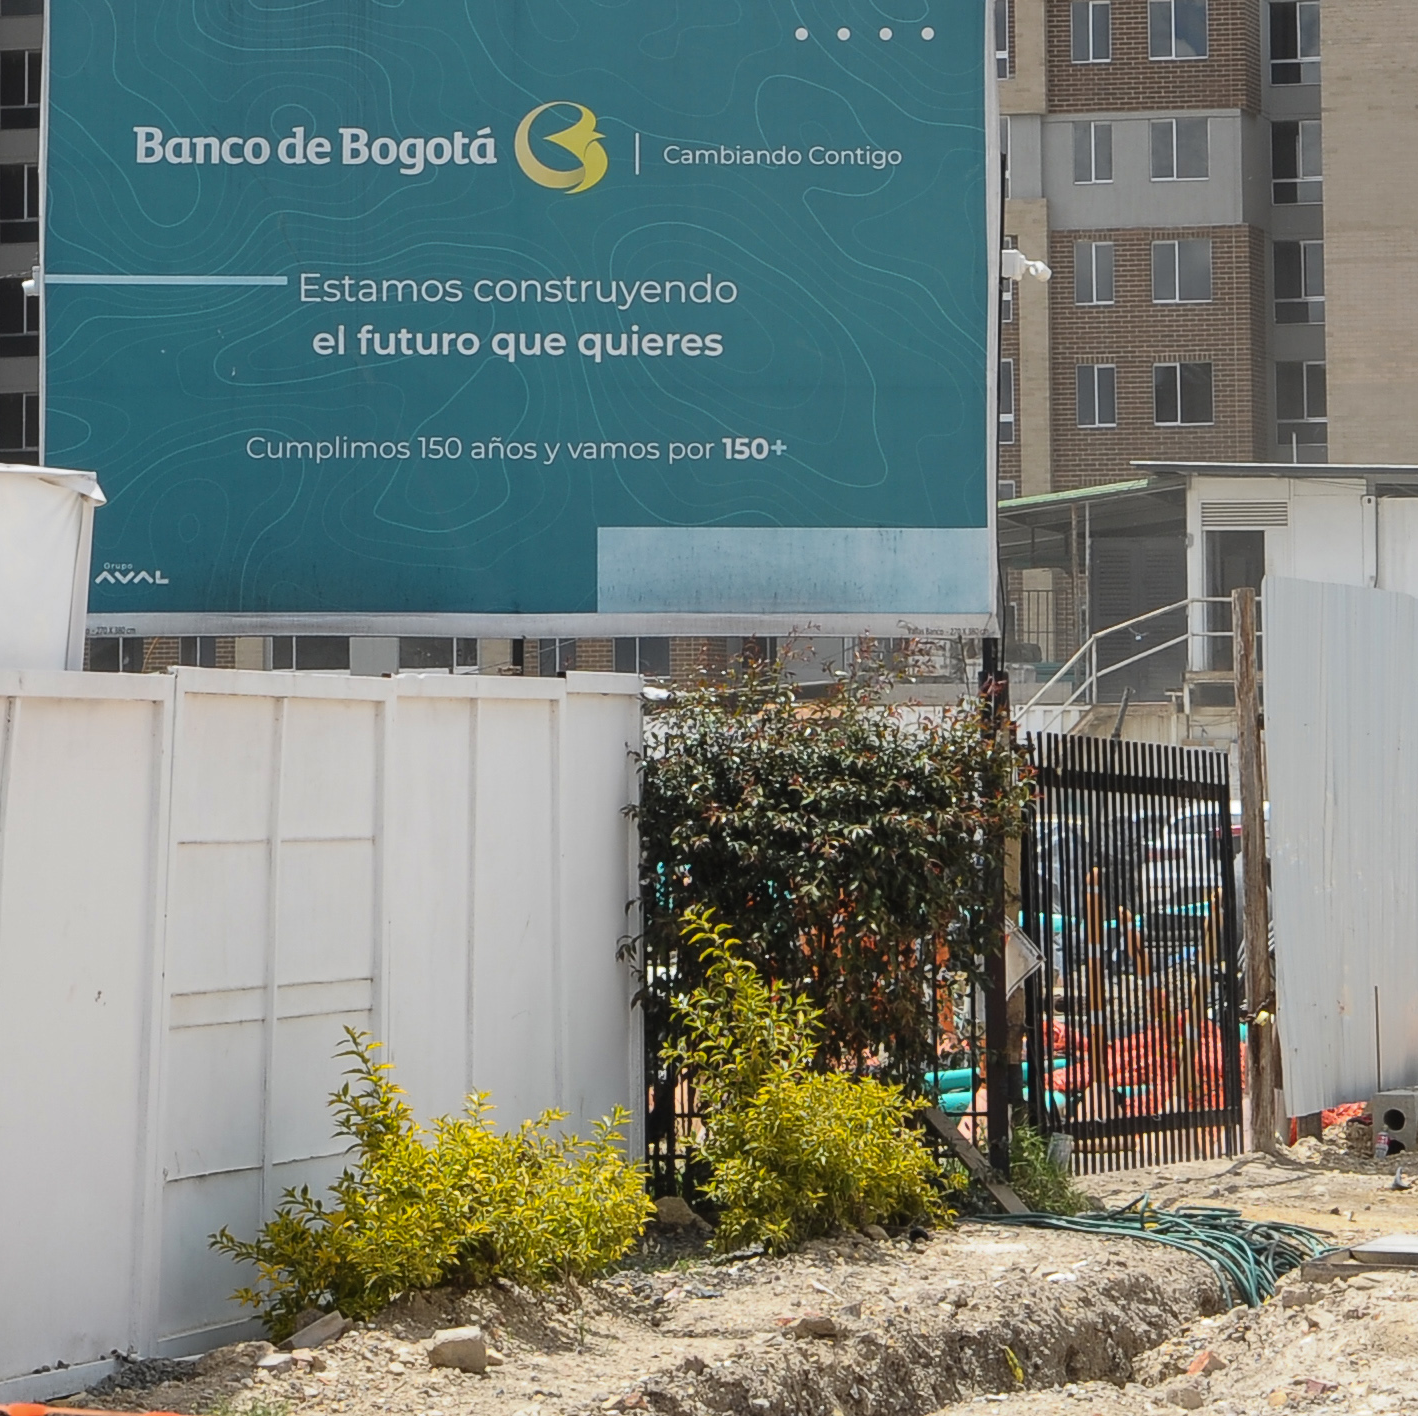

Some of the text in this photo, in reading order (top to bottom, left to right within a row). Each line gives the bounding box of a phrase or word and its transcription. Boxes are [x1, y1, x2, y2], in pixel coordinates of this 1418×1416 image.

[133, 126, 498, 175] Banco de Bogotá
[663, 144, 902, 170] Cambiando Contigo
[299, 273, 738, 310] Estamos construyendo
[312, 324, 724, 363] el futuro que quieres
[246, 436, 787, 465] Cumplimos 150 años y vamos por 150+
[94, 570, 169, 584] AVAL
[103, 562, 133, 570] Grupo
